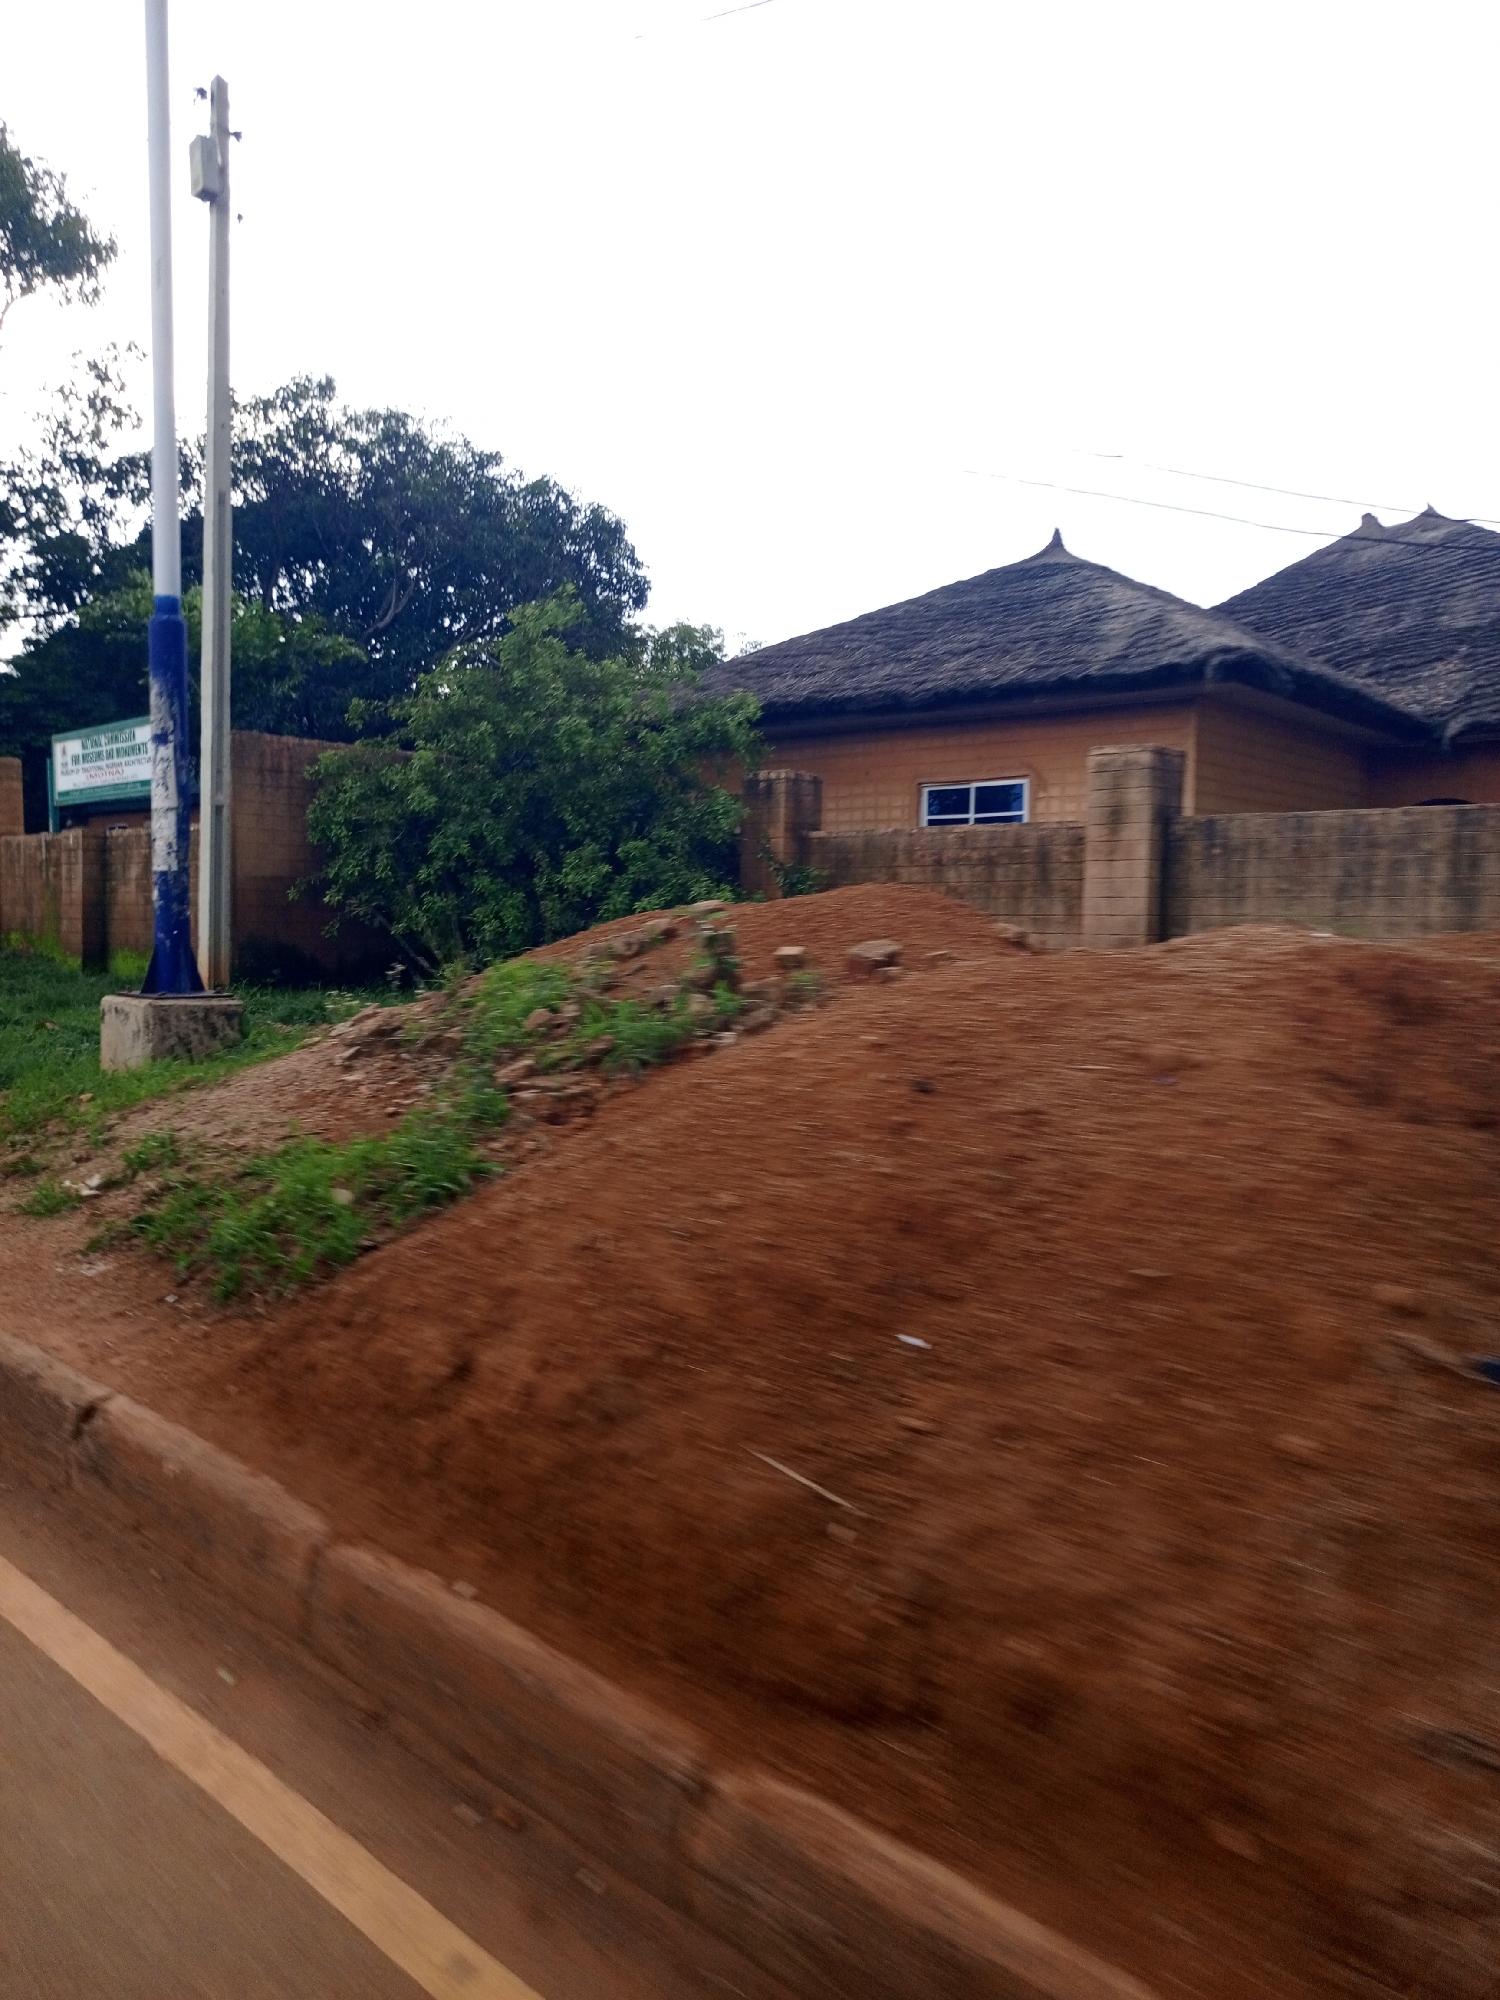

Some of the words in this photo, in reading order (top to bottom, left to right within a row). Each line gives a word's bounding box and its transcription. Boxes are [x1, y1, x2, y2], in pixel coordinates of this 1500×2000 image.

[104, 729, 136, 746] COMMISSION
[72, 754, 80, 766] FOR
[82, 749, 105, 764] MUSEUMS
[106, 747, 114, 760] AND
[116, 742, 148, 758] MONUMENTS
[124, 757, 152, 766] ARCHITECTUR
